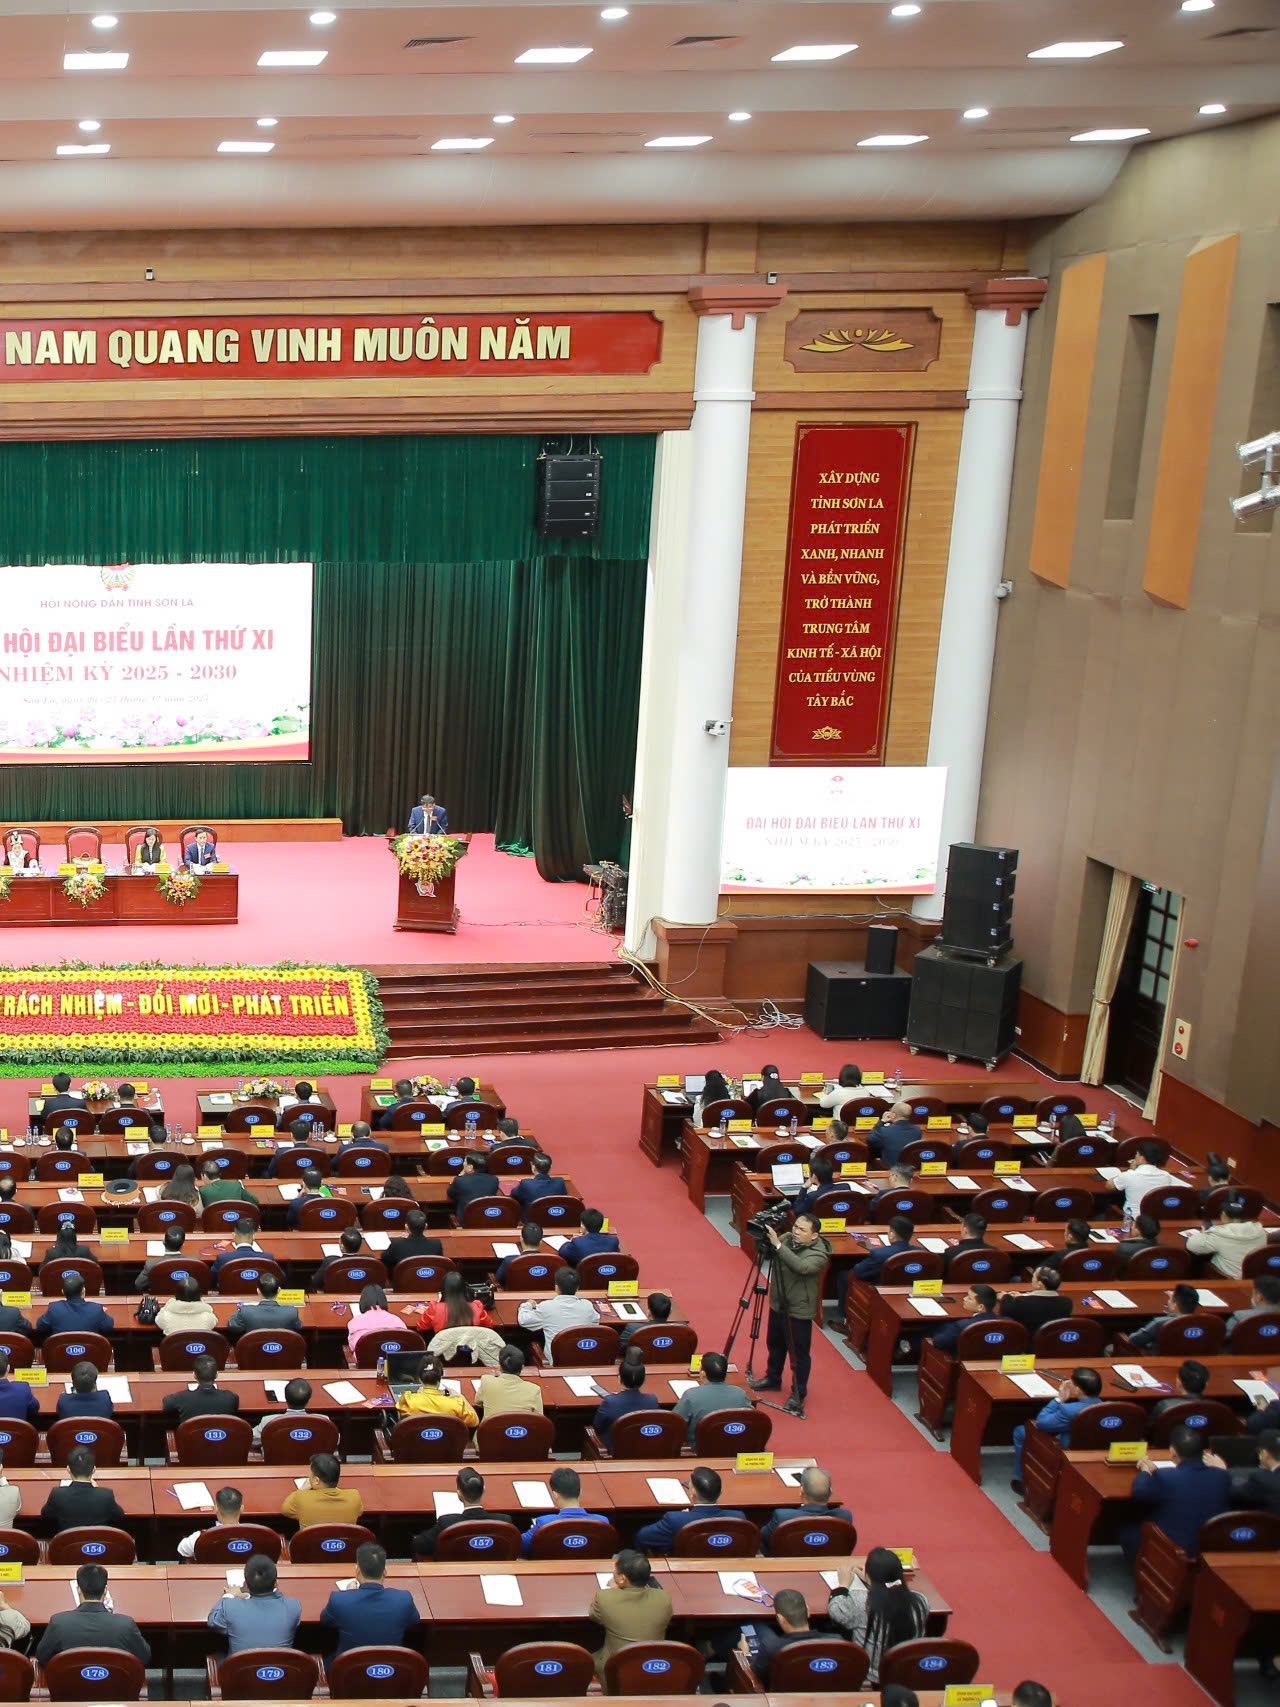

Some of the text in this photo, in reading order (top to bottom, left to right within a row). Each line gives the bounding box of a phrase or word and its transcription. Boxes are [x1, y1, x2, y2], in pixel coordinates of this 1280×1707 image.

[5, 328, 97, 365] NAM
[107, 328, 240, 369] QUANG
[251, 327, 342, 365] VINH
[353, 316, 468, 363] MUÔN
[478, 317, 571, 362] NĂM
[819, 471, 879, 485] XÂY DỰNG
[811, 496, 883, 508] TỈNH SƠN LA
[811, 519, 880, 533] PHÁT TRIỂN
[801, 549, 884, 561] XANH, NHANH
[801, 569, 879, 585] VÀ BỀN VỮNG,
[805, 595, 872, 608] TRỞ THÀNH
[803, 621, 870, 633] TRUNG TÂM
[4, 628, 40, 657] HỘI
[48, 632, 84, 656] ĐẠI
[94, 622, 143, 652] BIỂU
[252, 629, 273, 650] XI
[787, 648, 817, 658] KINH
[819, 643, 834, 657] TẾ
[841, 646, 857, 657] XÃ
[860, 645, 881, 660] HỘI
[122, 665, 168, 680] 2025
[190, 664, 237, 680] 2030
[789, 668, 875, 682] CỦA TIỂU VÙNG
[807, 690, 853, 706] TÂY BẮC
[60, 990, 122, 1020] NHIỆM
[139, 983, 173, 1014] ĐỔI
[180, 988, 219, 1015] MỚI
[232, 990, 282, 1015] PHÁT
[289, 984, 350, 1016] TRIỂN
